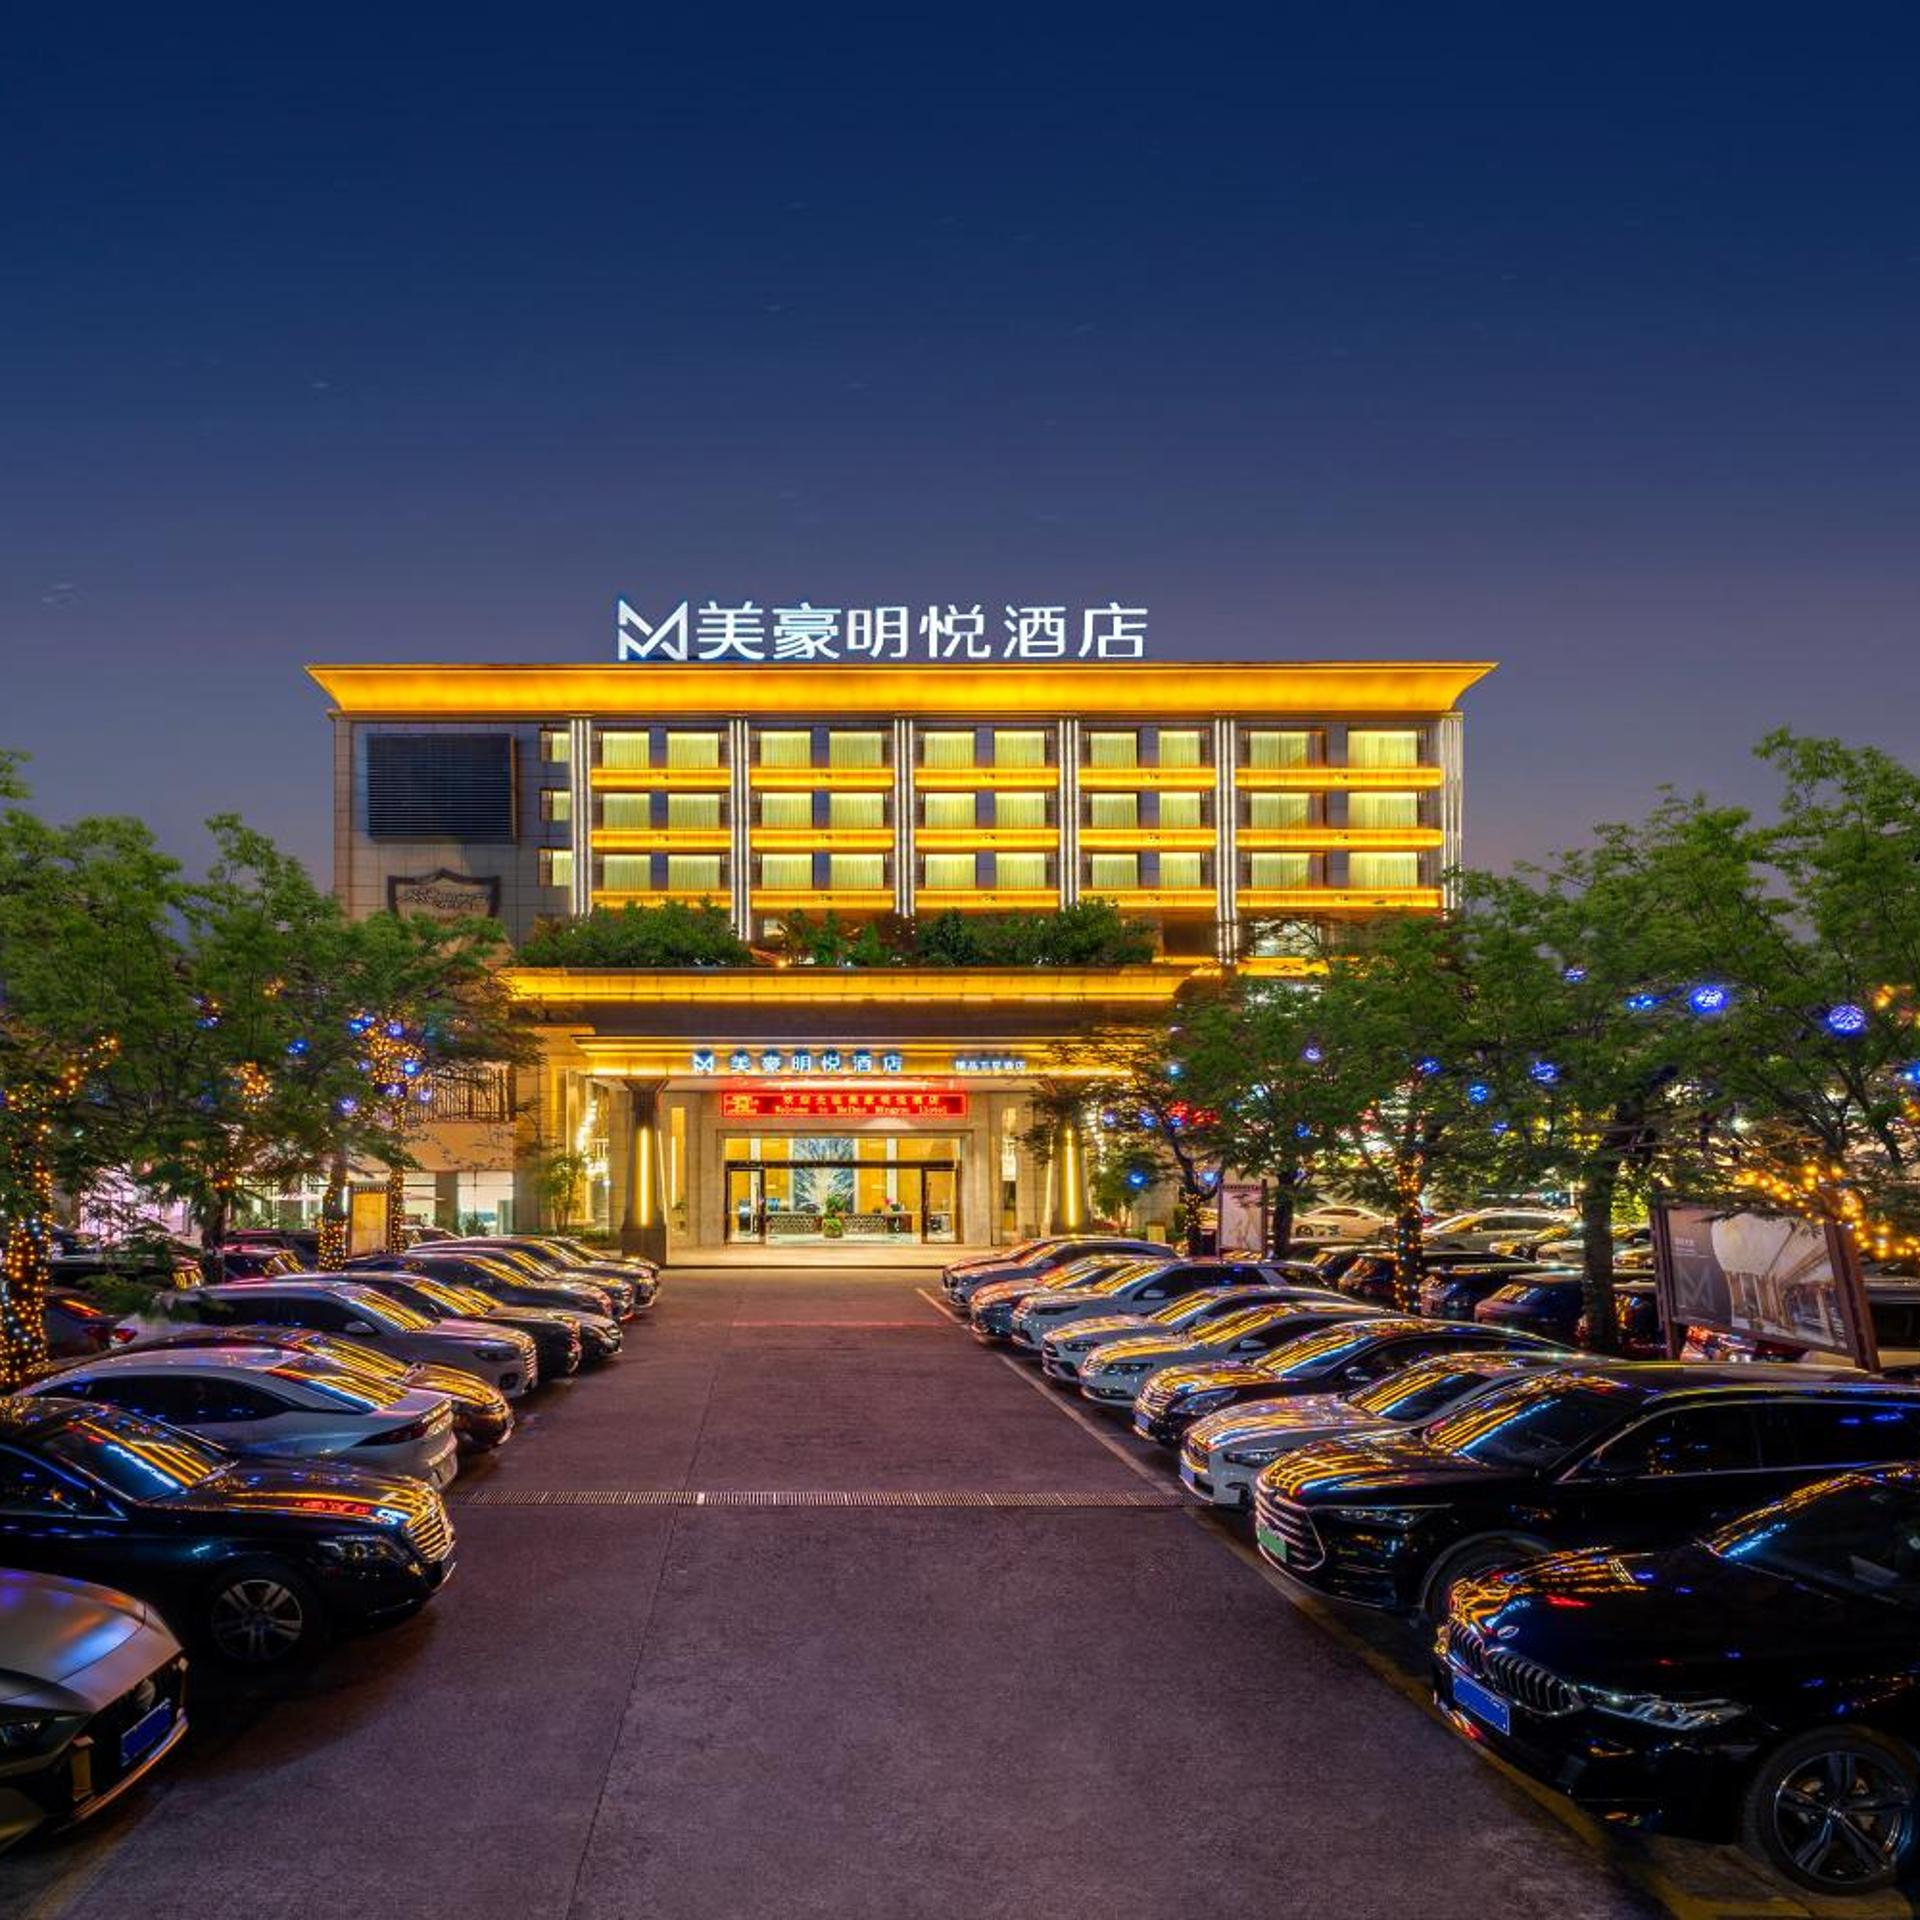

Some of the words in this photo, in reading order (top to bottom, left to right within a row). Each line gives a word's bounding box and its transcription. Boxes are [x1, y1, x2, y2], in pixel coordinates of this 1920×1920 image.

[696, 600, 1149, 660] 美豪明悦酒店
[729, 1053, 903, 1073] 美豪明悦酒店
